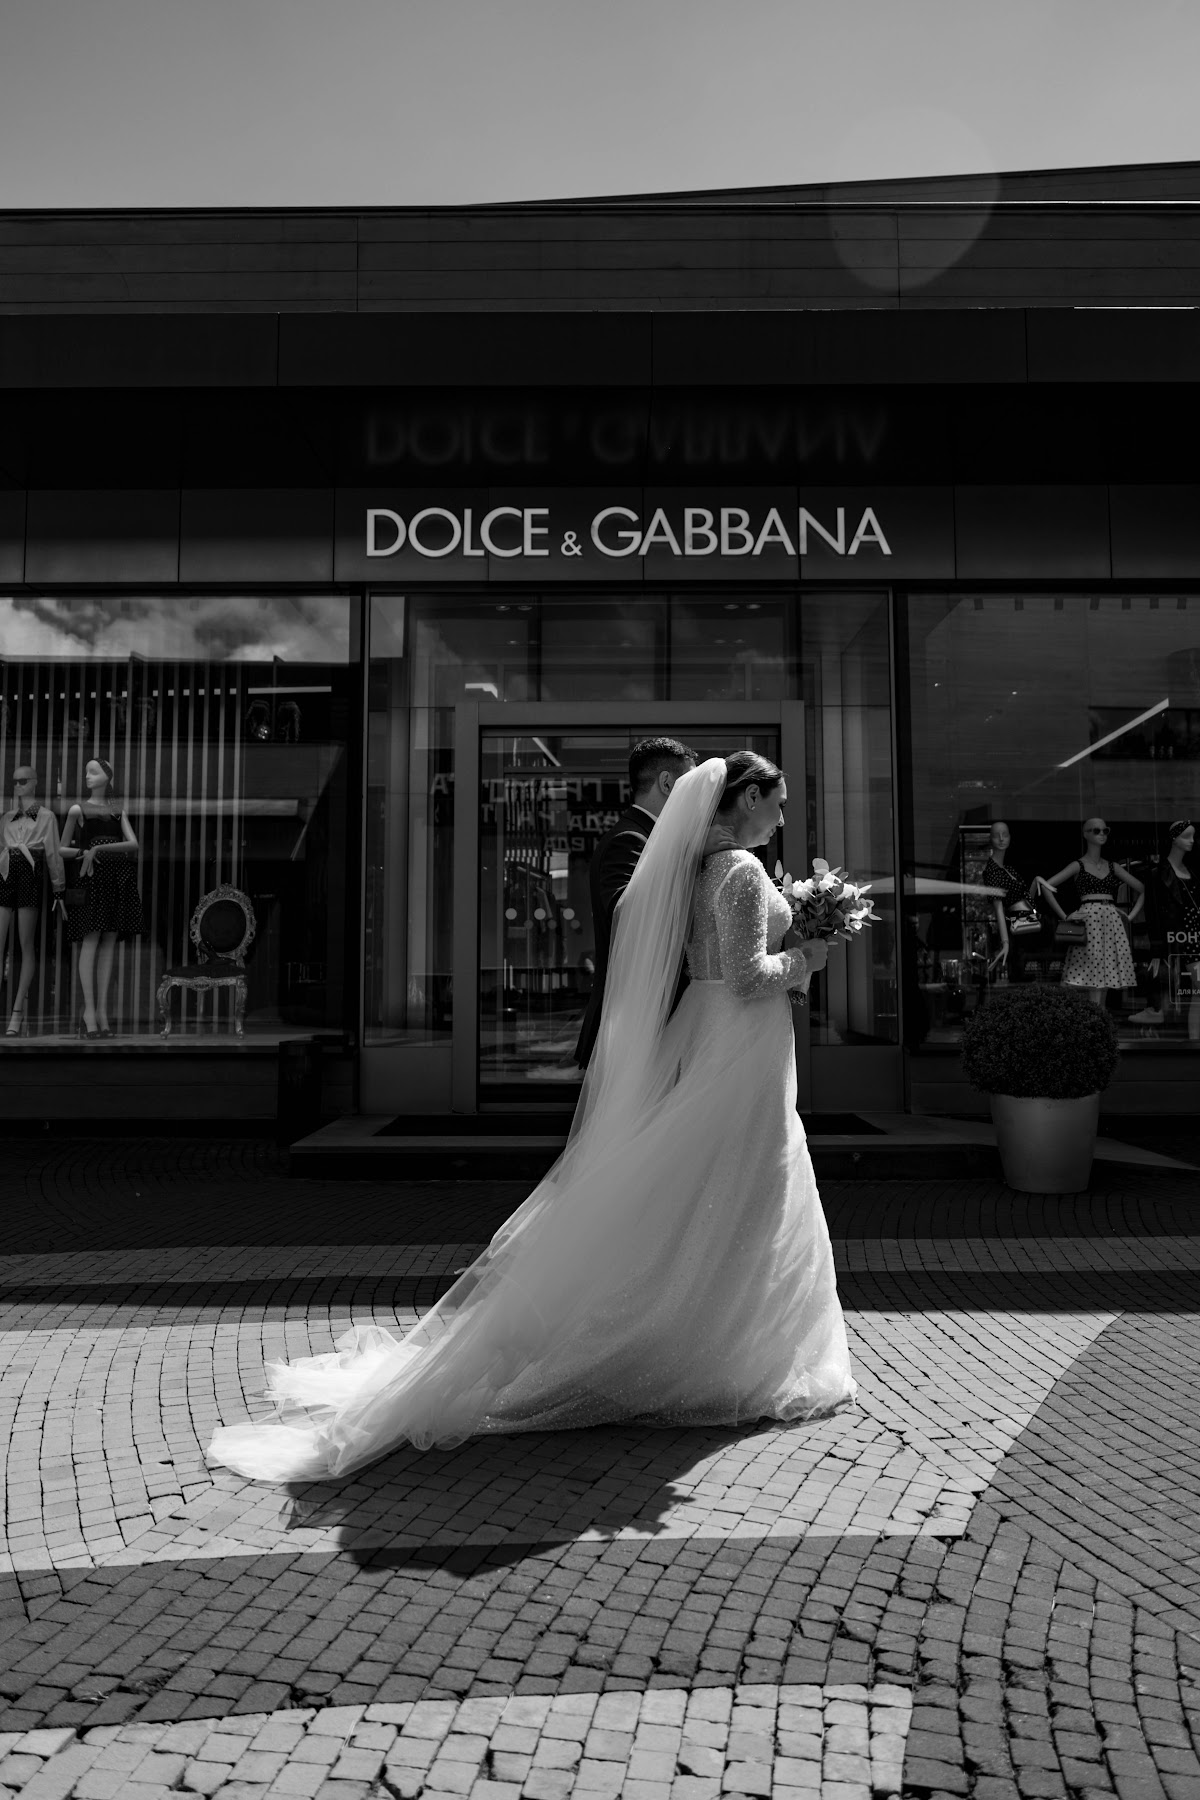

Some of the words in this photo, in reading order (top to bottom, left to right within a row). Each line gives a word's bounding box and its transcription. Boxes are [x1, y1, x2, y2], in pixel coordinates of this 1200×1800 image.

[366, 507, 549, 557] DOLCE
[561, 531, 583, 556] &
[592, 507, 892, 557] GABBANA
[1166, 931, 1200, 943] БОН
